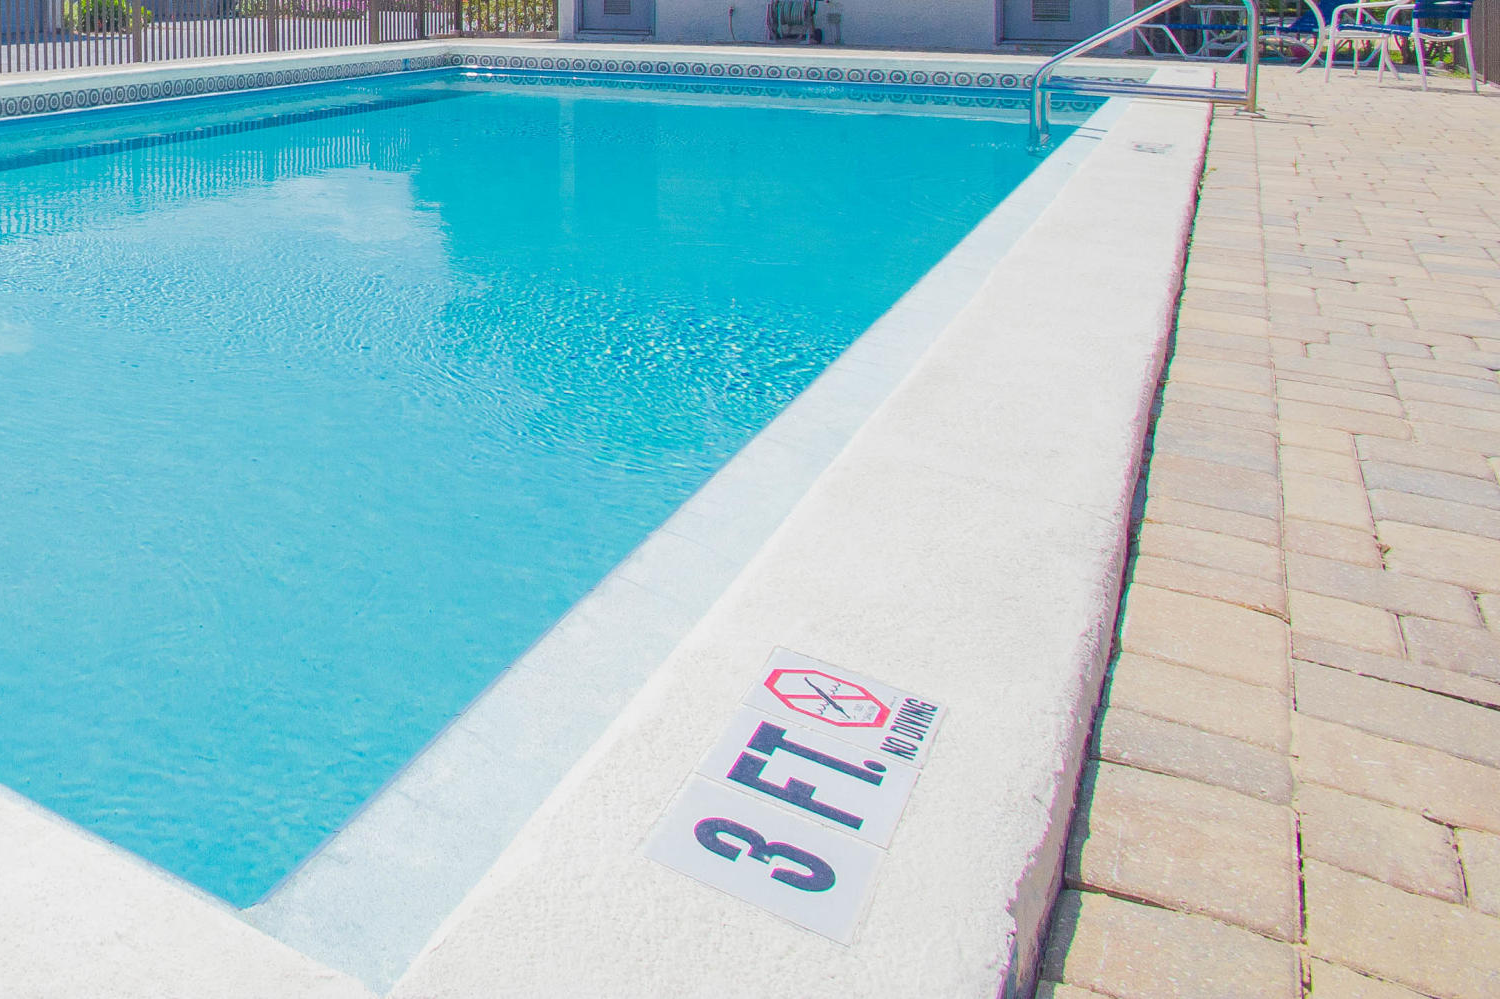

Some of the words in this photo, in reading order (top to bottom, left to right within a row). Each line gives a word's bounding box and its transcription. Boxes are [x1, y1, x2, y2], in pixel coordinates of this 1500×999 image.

[880, 736, 918, 760] NO
[890, 697, 938, 741] DIVING
[726, 720, 887, 831] FT.
[693, 816, 836, 892] 3
